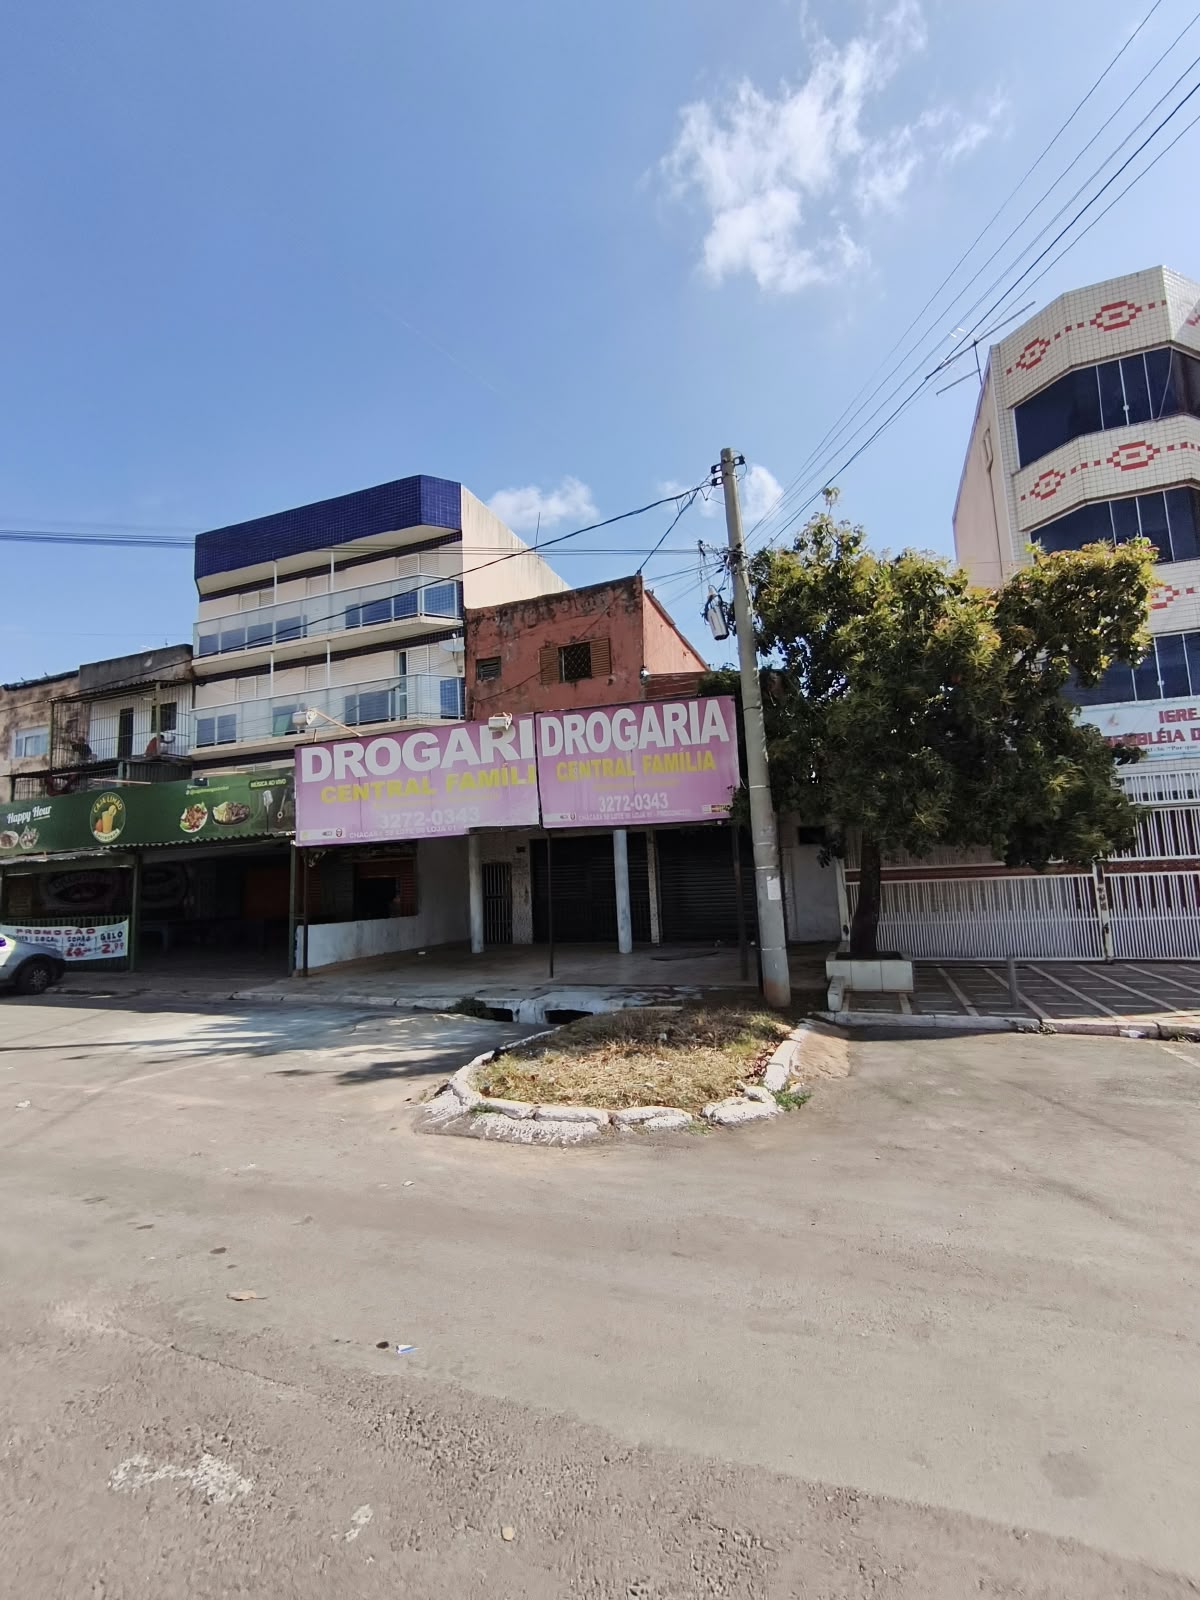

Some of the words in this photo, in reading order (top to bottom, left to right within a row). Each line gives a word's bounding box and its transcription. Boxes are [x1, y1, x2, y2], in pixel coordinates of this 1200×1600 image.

[540, 699, 730, 757] DROGARIA
[556, 757, 637, 783] CENTRAL
[642, 750, 716, 773] FAMÍLIA
[321, 776, 438, 804] CENTRAL
[599, 792, 669, 812] 3272-0343
[7, 811, 31, 825] Happy
[32, 805, 52, 818] Hour
[378, 806, 481, 829] 3272-0343
[100, 931, 123, 940] GELO
